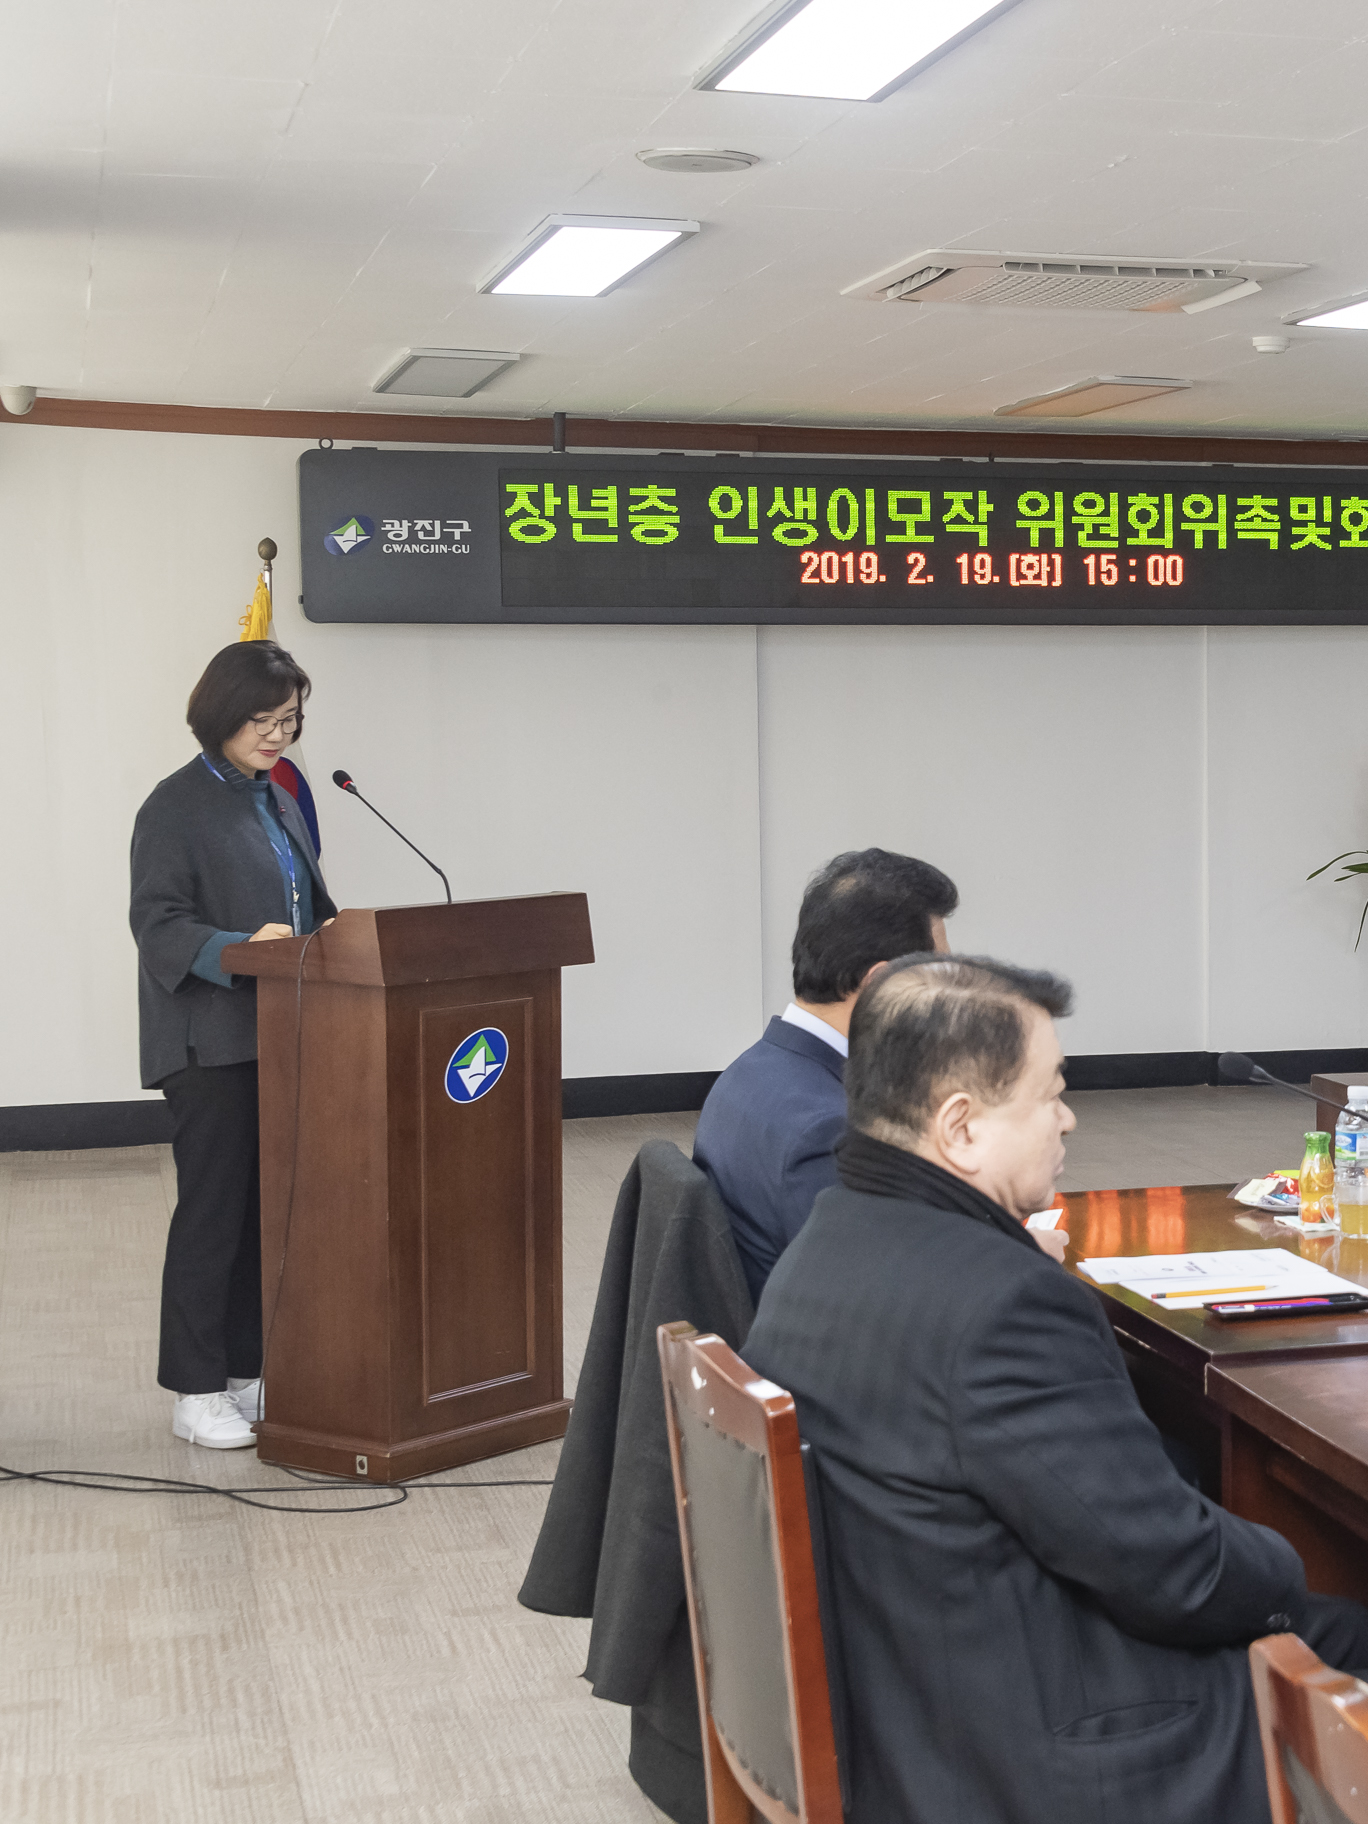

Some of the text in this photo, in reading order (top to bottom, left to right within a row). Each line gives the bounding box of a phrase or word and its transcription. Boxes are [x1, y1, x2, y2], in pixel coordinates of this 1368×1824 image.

[505, 483, 680, 545] 장년층
[709, 485, 994, 547] 인생이모작
[381, 519, 472, 541] 광진구
[382, 543, 470, 554] GWANGJIN-GU
[800, 551, 887, 584] 2019.
[906, 552, 934, 584] 2.
